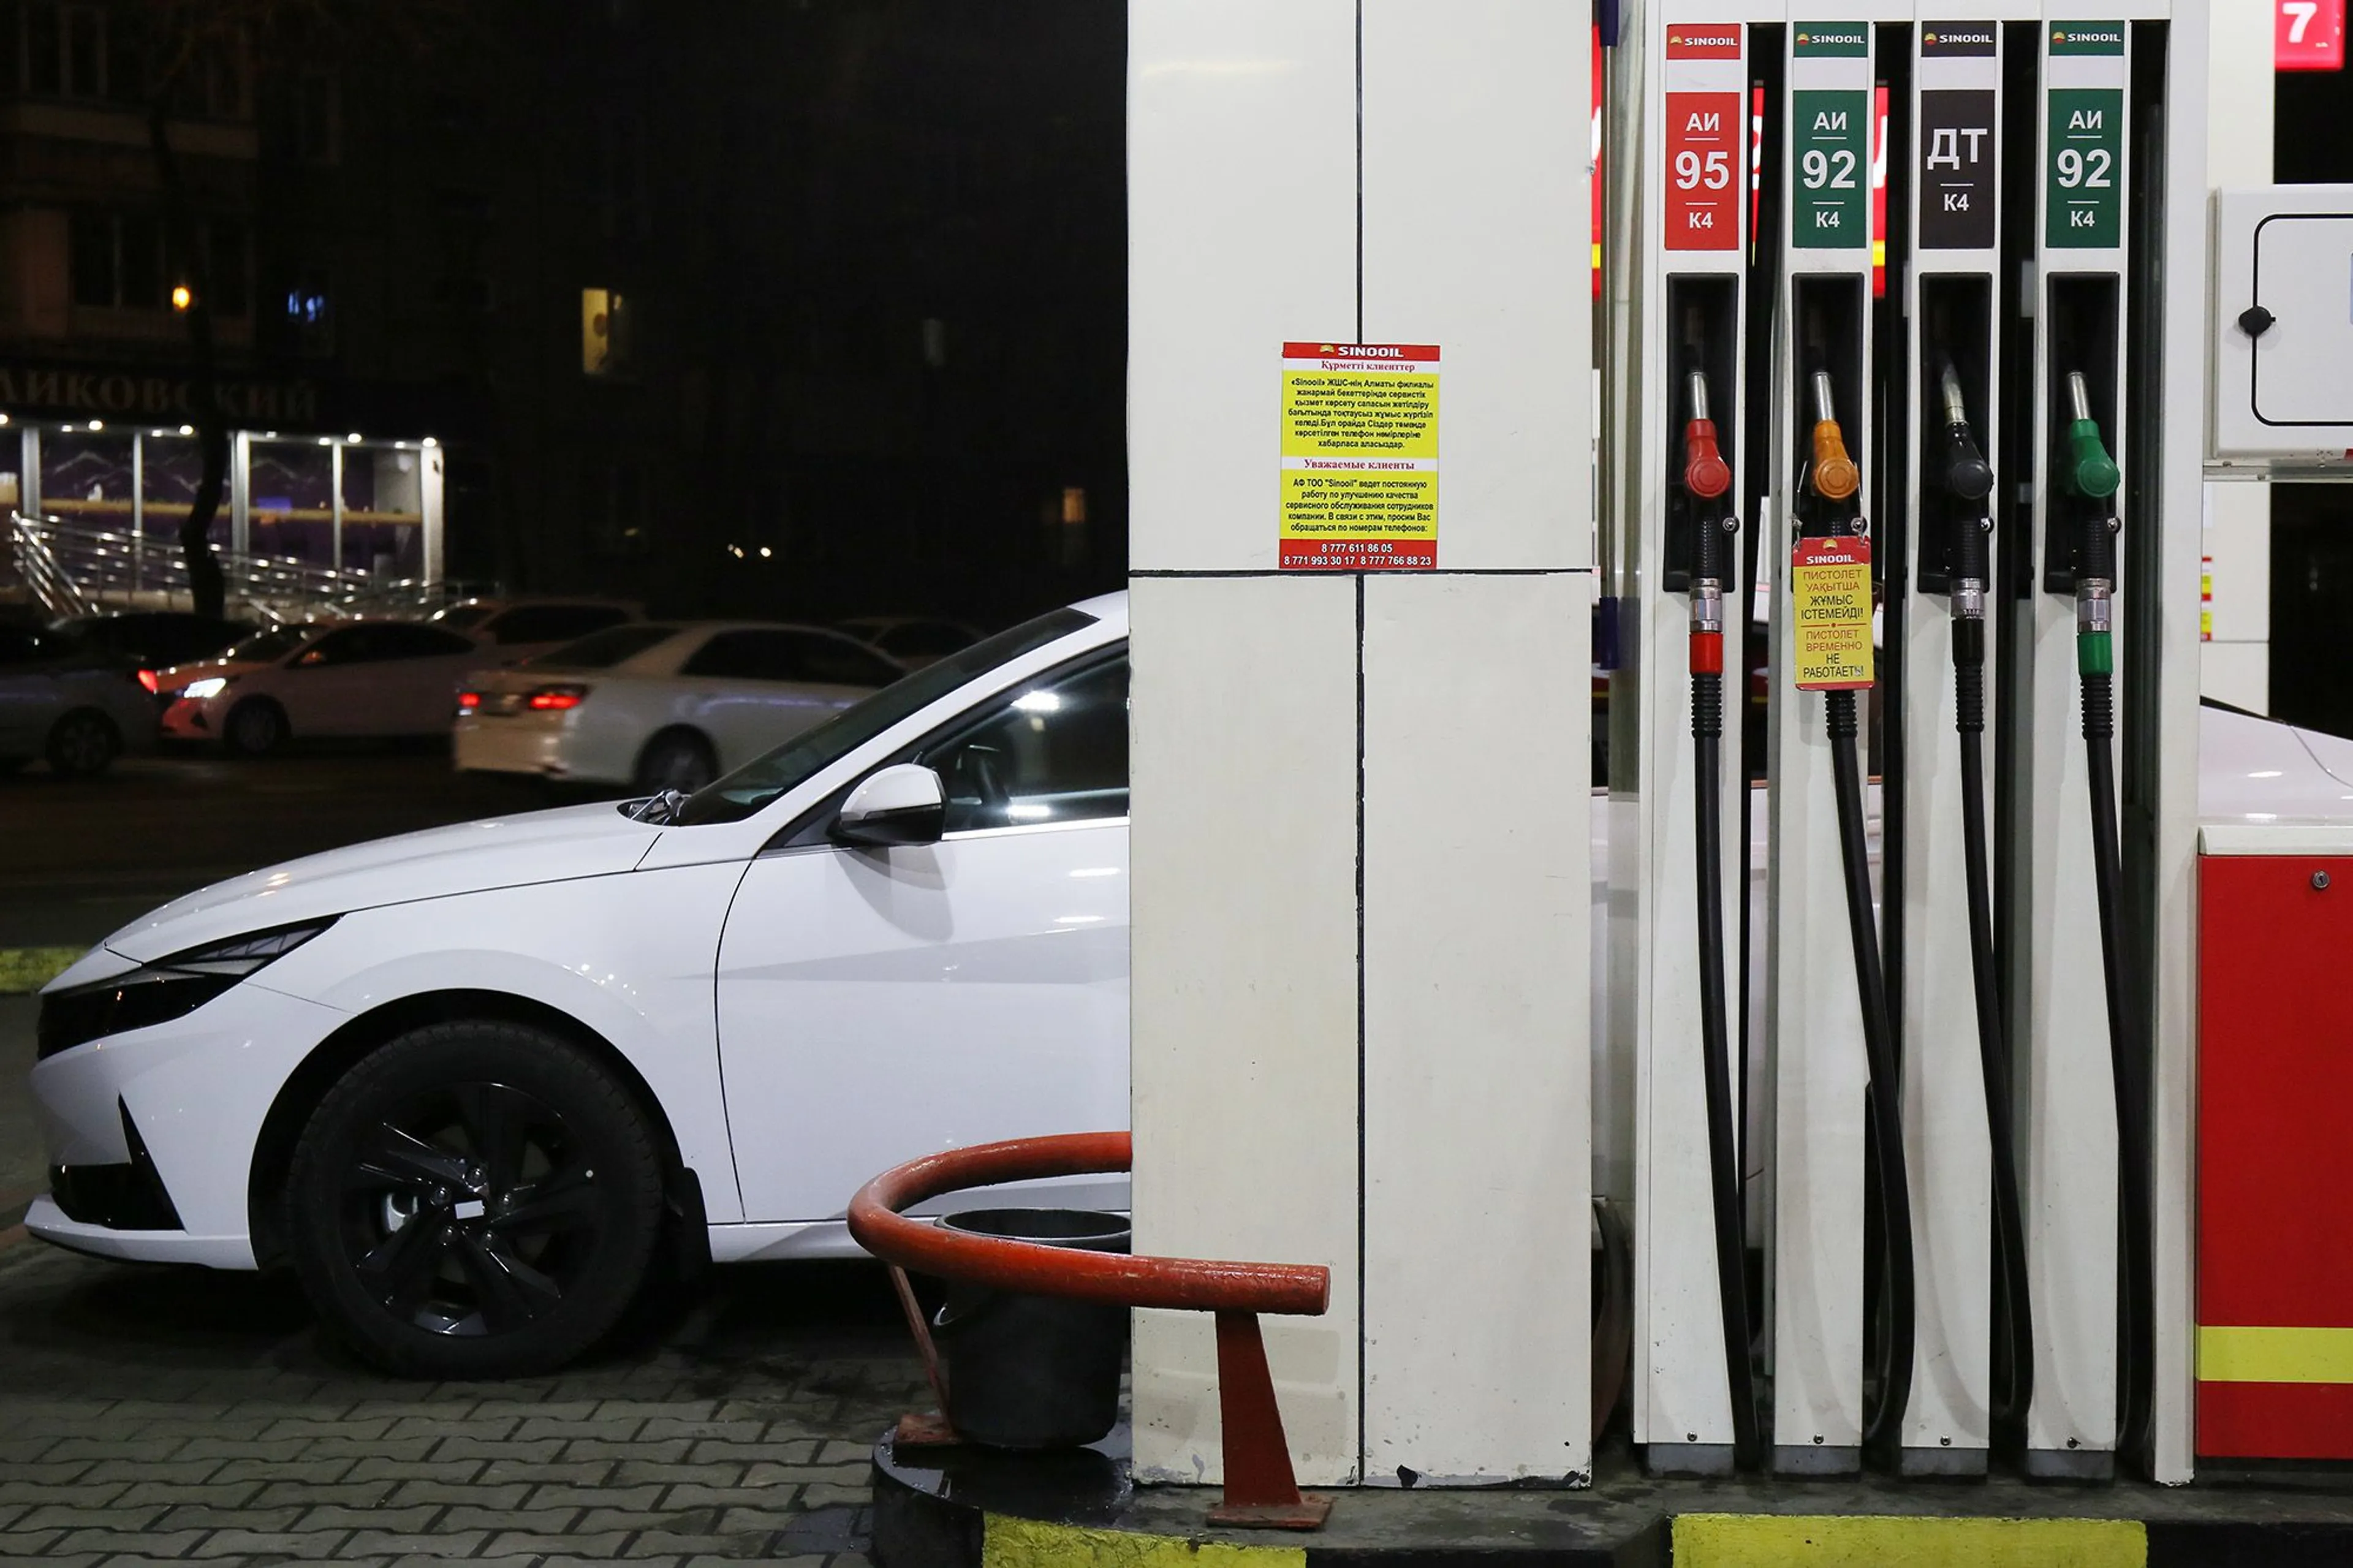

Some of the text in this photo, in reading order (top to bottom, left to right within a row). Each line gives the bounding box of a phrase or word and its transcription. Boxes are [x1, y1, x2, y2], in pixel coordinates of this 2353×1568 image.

[1684, 37, 1738, 46] SINOOIL
[1812, 35, 1865, 44] SINOOIL
[1939, 34, 1993, 44] SINOOIL
[2067, 33, 2121, 42] SINOOIL
[1686, 113, 1720, 132] АИ
[1813, 112, 1847, 131] АИ
[2069, 110, 2102, 129] АИ
[1927, 128, 1988, 170] ДТ
[1675, 151, 1729, 189] 95
[1802, 150, 1856, 189] 92
[2057, 149, 2111, 187] 92
[1944, 194, 1969, 211] К4
[1689, 212, 1713, 229] К4
[1816, 212, 1840, 228] К4
[2071, 211, 2094, 227] К4
[1338, 346, 1404, 357] SINOOIL
[1366, 363, 1415, 373] клиенттер
[1396, 380, 1434, 389] филиалы
[1341, 430, 1374, 439] телефон
[1304, 459, 1365, 469] Уважаемые
[1293, 479, 1305, 487] АФ
[1307, 479, 1323, 487] ТОО
[1382, 481, 1427, 490] постоянную
[1302, 490, 1328, 500] работу
[1341, 491, 1384, 500] улучшению
[1286, 501, 1434, 512] сервисного обслуживания сотрудников
[1328, 512, 1334, 520] В
[1417, 513, 1431, 521] Вас
[1290, 523, 1336, 532] обращаться
[1349, 525, 1382, 533] номерам
[1321, 543, 1393, 553] 8 777 611 86 05
[1311, 556, 1328, 565] 993
[1330, 556, 1342, 565] 30
[1344, 556, 1355, 565] 17
[1360, 556, 1366, 565] 8
[1369, 556, 1385, 565] 777
[1388, 556, 1404, 565] 766
[1806, 554, 1855, 564] SINOOIL
[1803, 569, 1863, 580] ПИСТОЛЕТ
[1807, 582, 1860, 594] УАҚЫТША
[1802, 606, 1863, 620] ІСТЕМЕЙДІ!
[1806, 630, 1859, 640] ПИСТОЛЕТ
[1806, 642, 1862, 651] ВРЕМЕННО
[1826, 653, 1840, 664] НЕ
